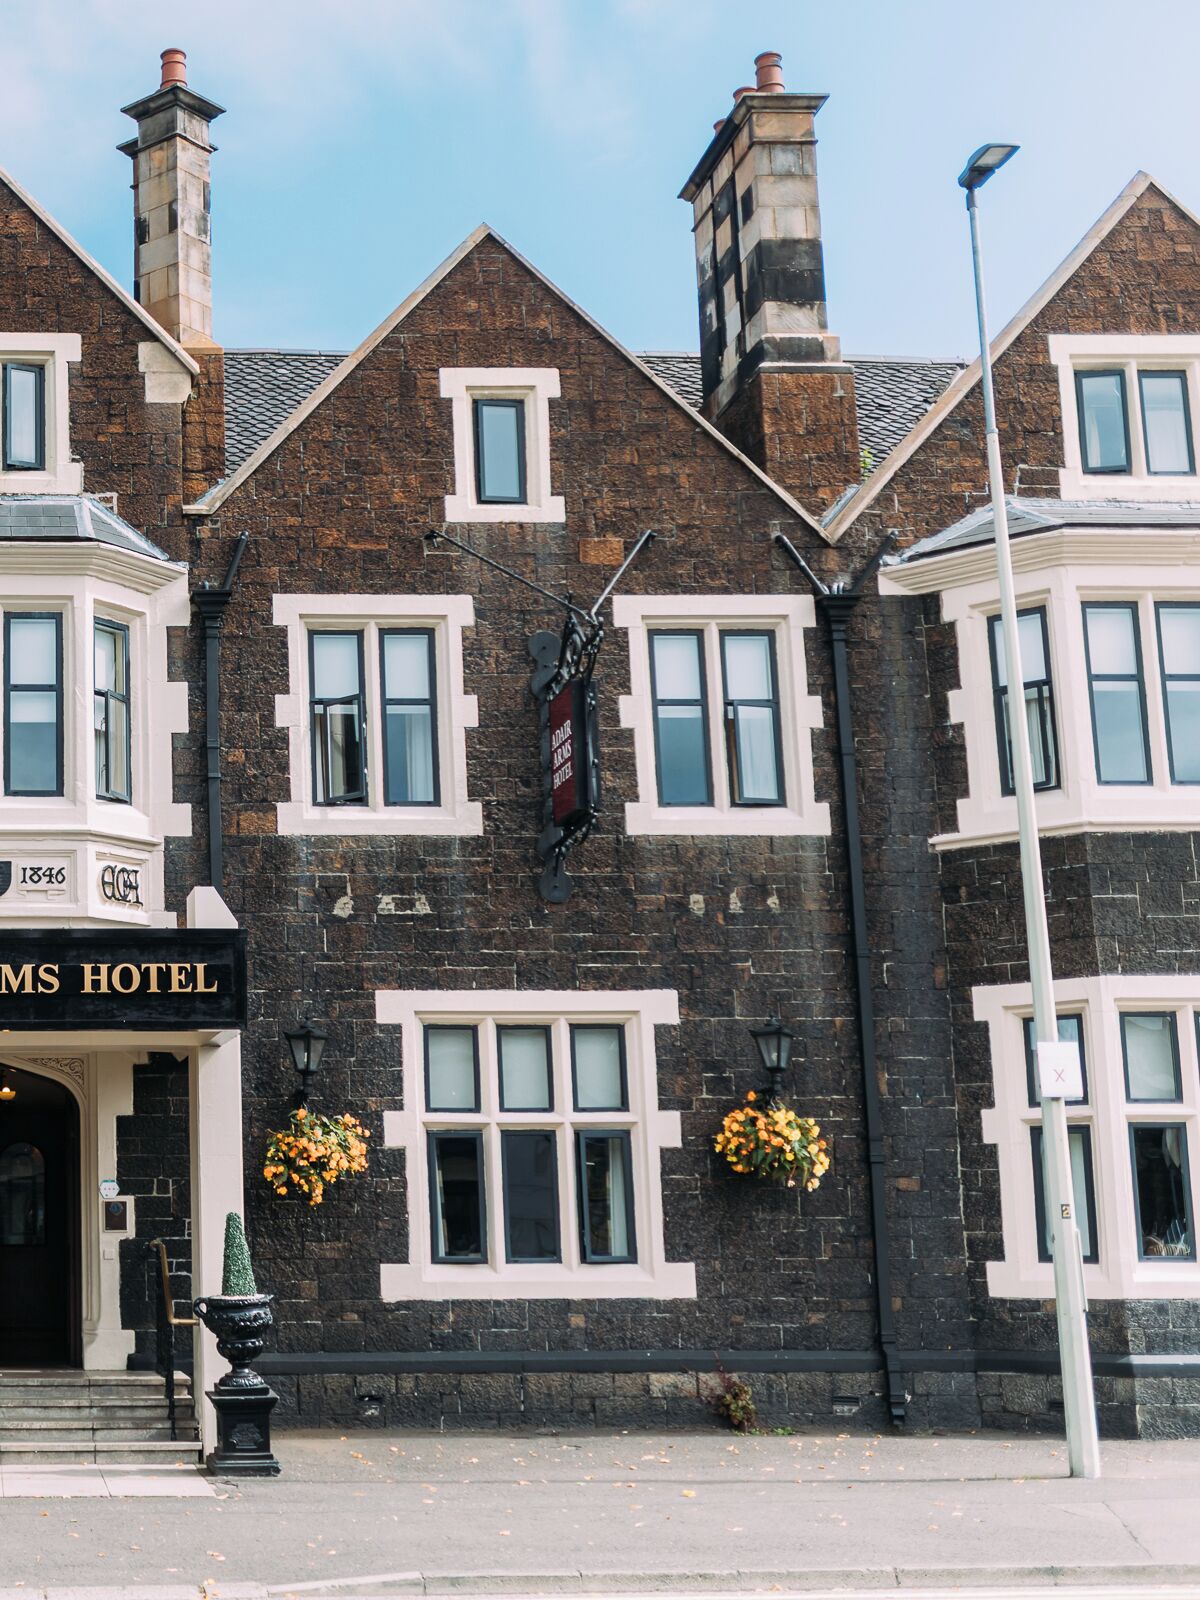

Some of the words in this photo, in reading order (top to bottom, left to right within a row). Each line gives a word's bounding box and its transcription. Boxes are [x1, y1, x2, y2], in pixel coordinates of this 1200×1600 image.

[551, 719, 573, 751] ADAIR
[553, 739, 572, 770] ARMS
[553, 761, 573, 790] HOTEL
[20, 866, 66, 885] 1846
[80, 963, 218, 994] HOTEL
